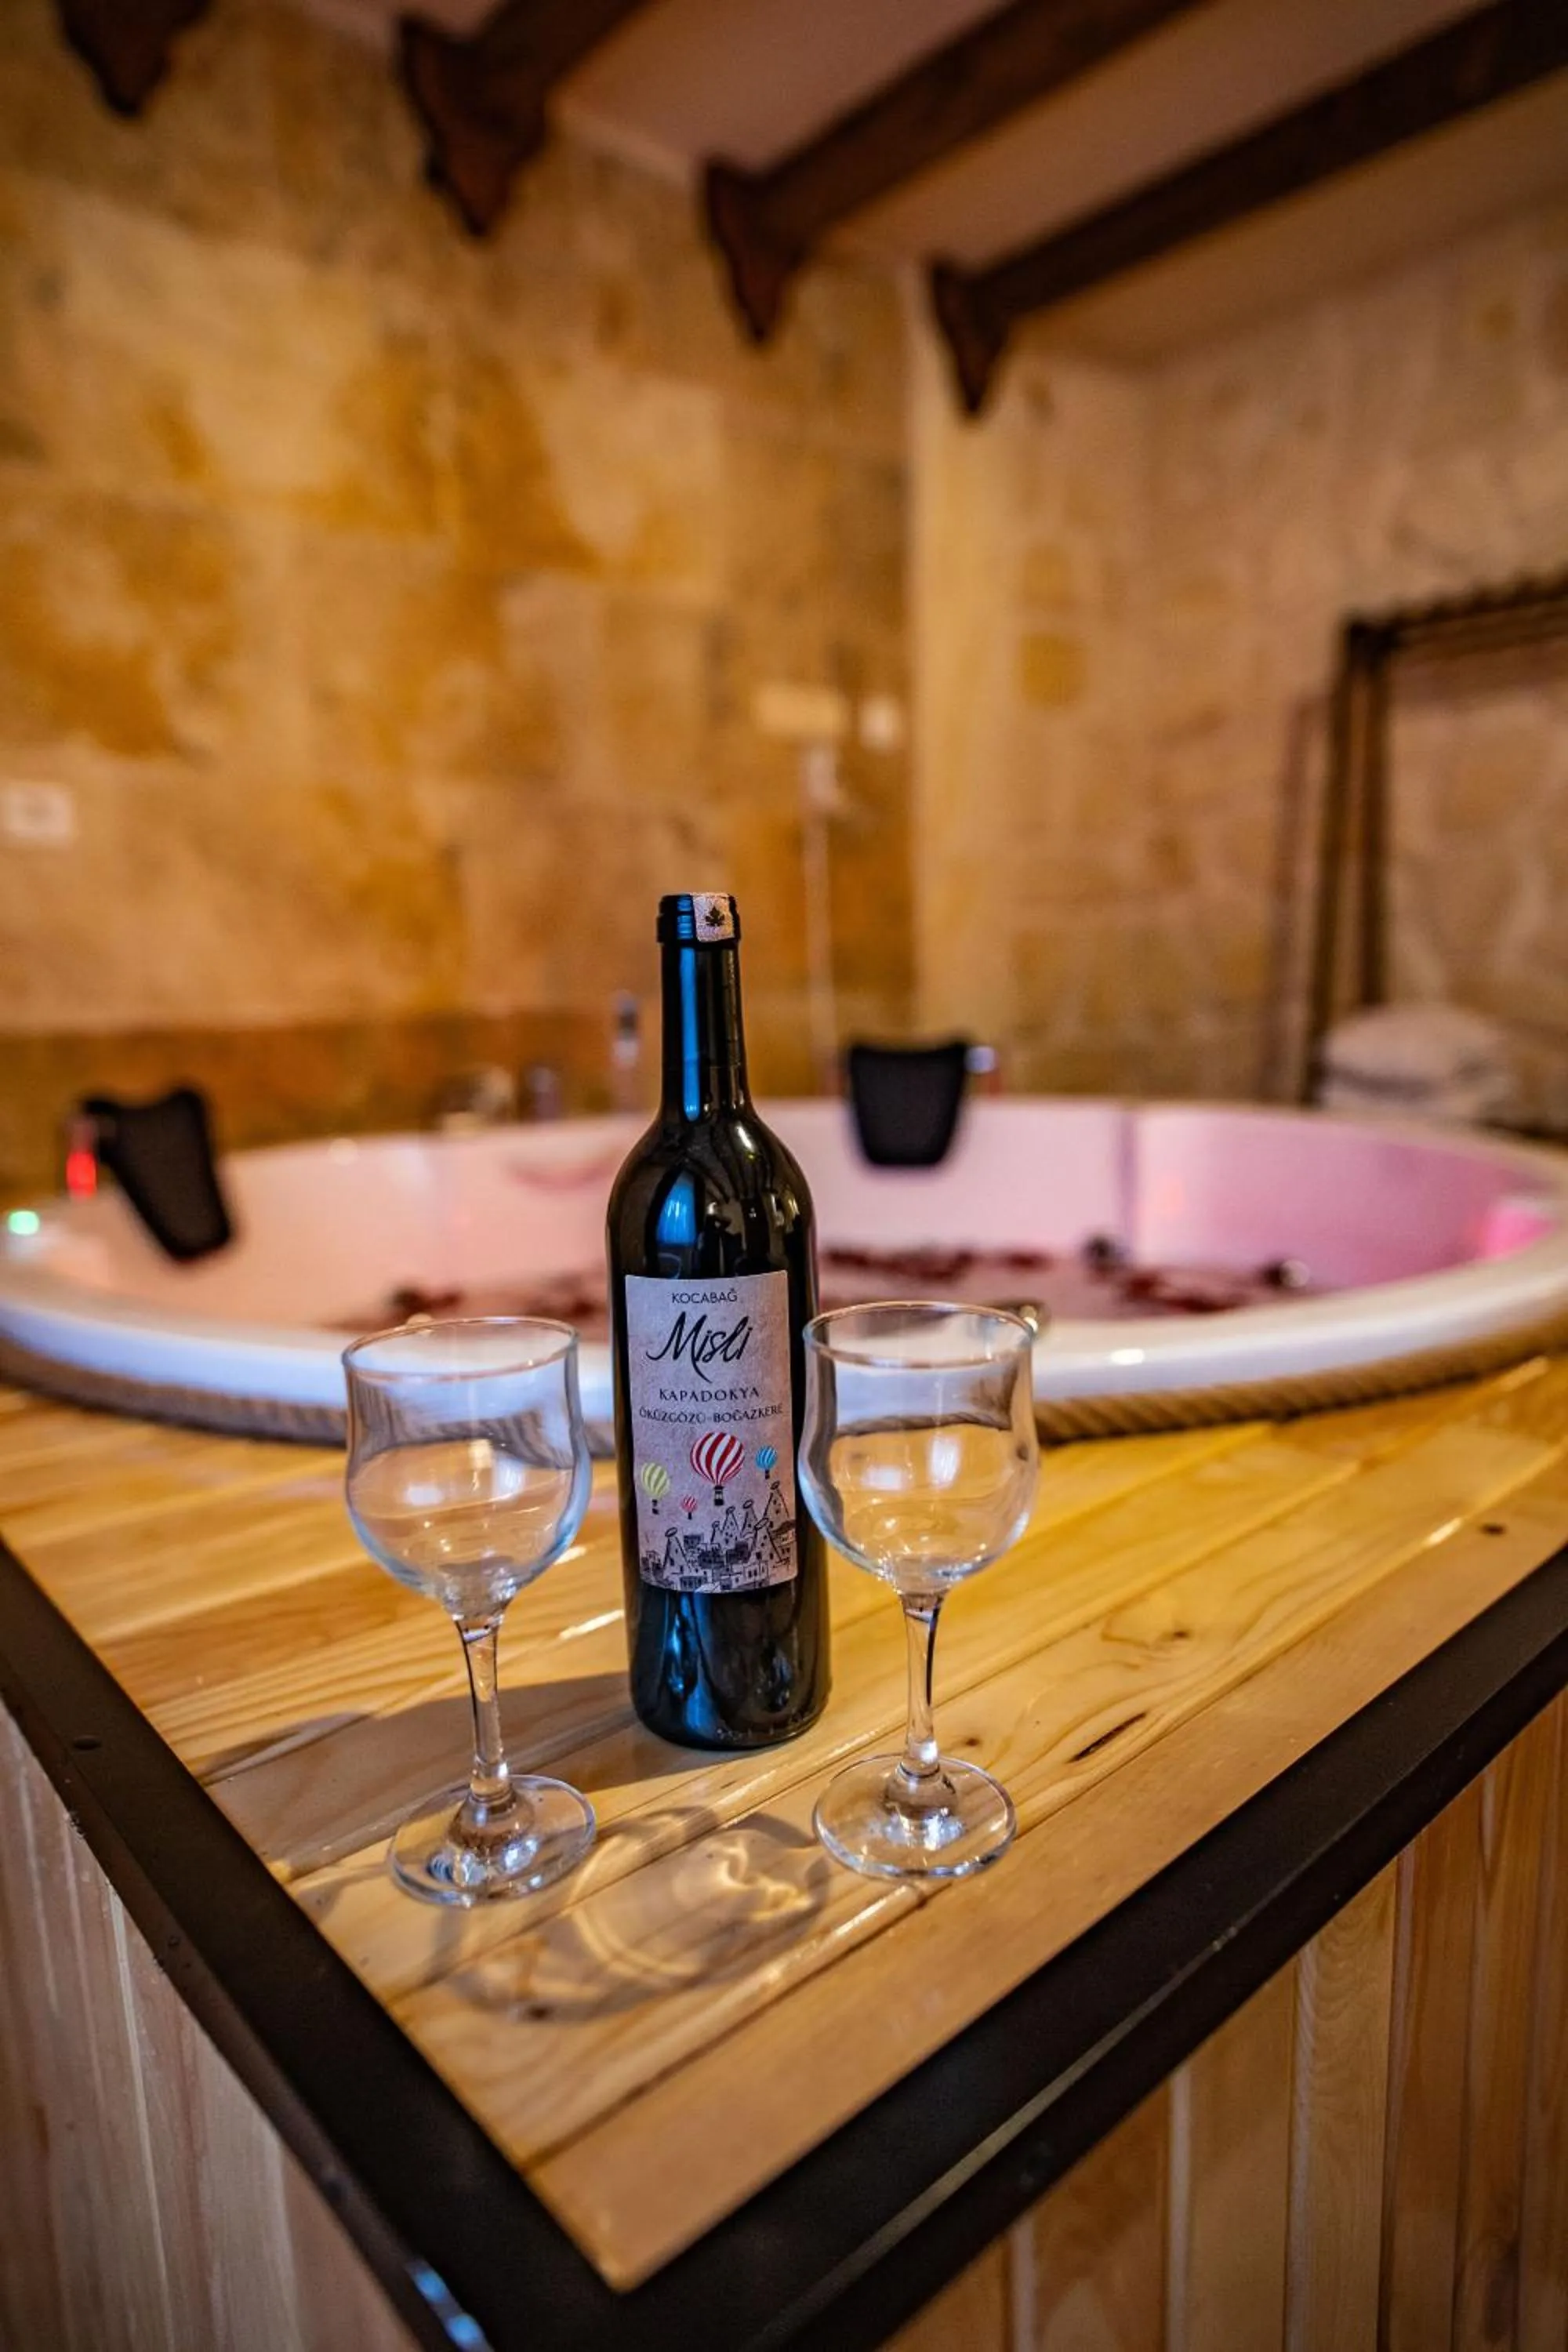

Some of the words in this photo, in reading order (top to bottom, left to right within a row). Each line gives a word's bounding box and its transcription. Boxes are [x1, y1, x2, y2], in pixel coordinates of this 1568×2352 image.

[671, 1287, 738, 1304] KOCABAĞ
[645, 1311, 753, 1385] Misli
[659, 1387, 760, 1403] KAPADOKYA
